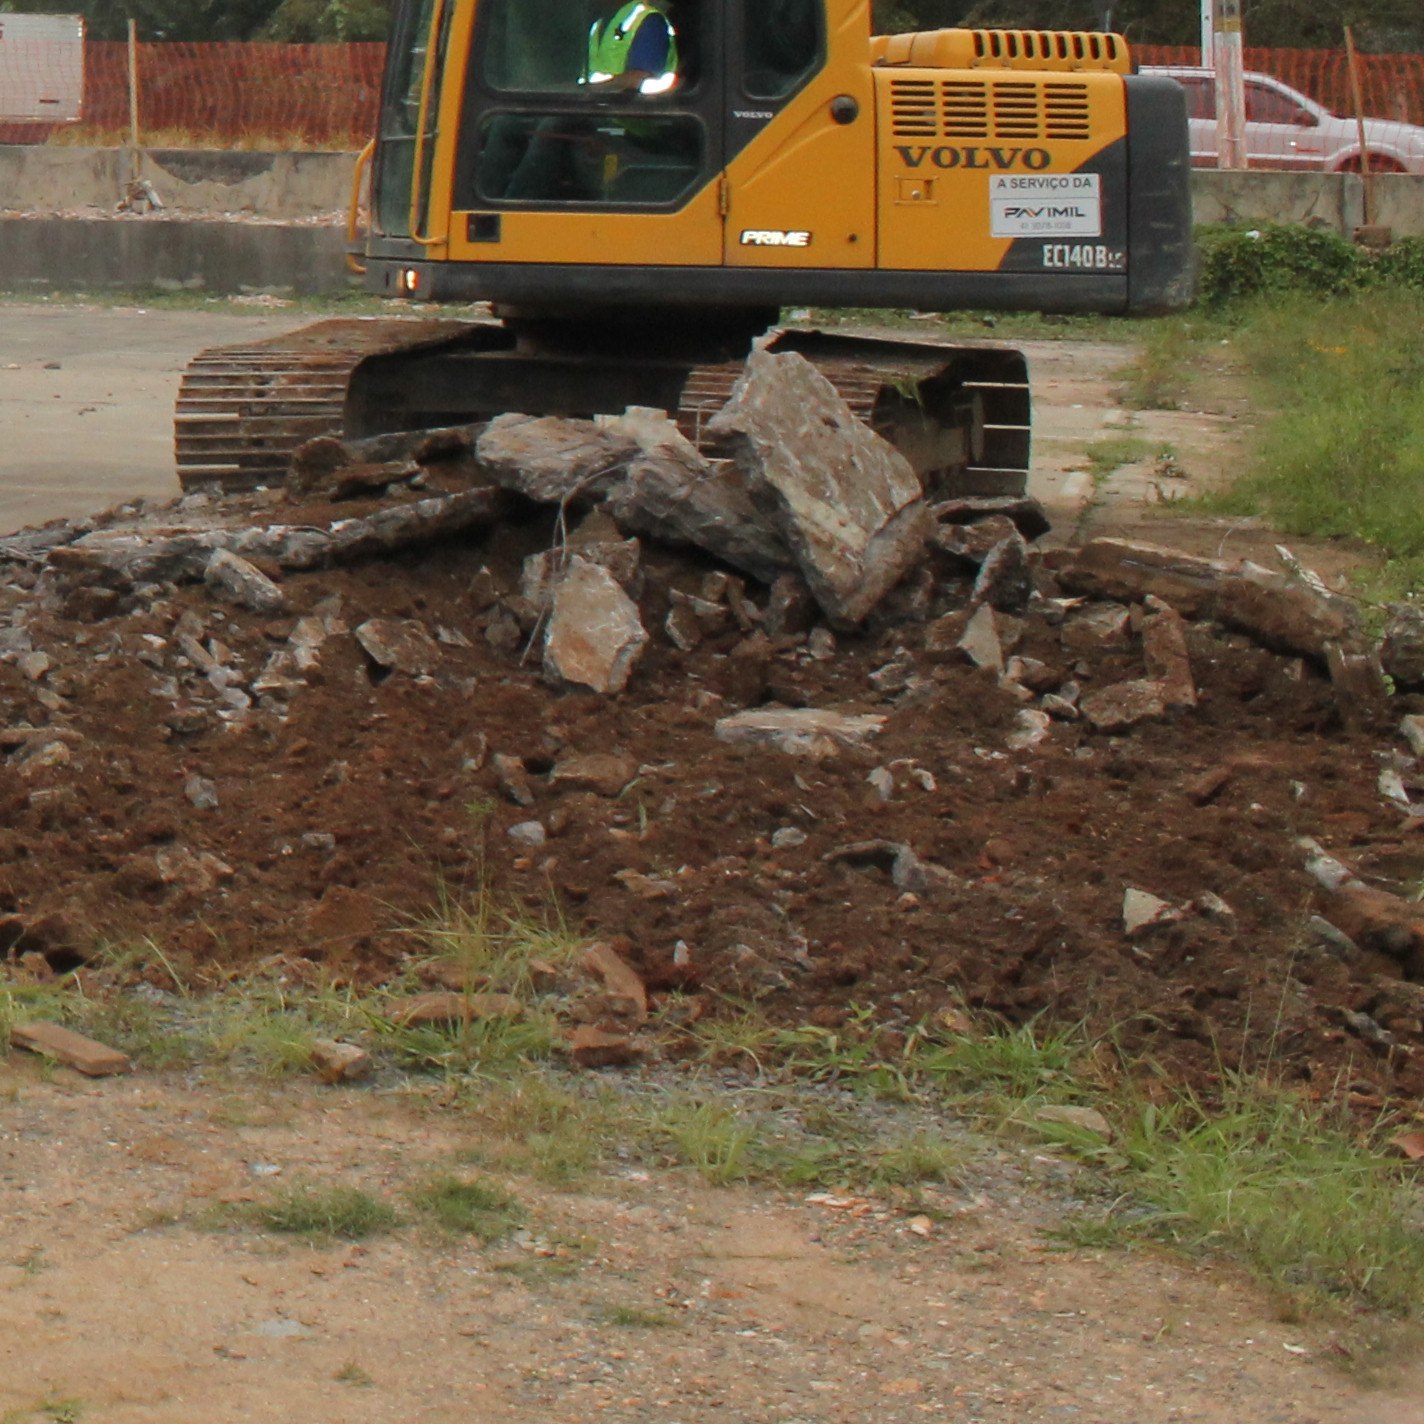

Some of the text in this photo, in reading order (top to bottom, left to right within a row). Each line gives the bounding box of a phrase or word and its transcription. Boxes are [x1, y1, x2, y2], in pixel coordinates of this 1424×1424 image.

[732, 110, 774, 119] VOLVO
[893, 146, 1051, 170] VOLVO
[998, 178, 1092, 191] A SERVIÇO DA
[1004, 207, 1086, 218] PAVIMIL
[740, 230, 812, 247] PRIME
